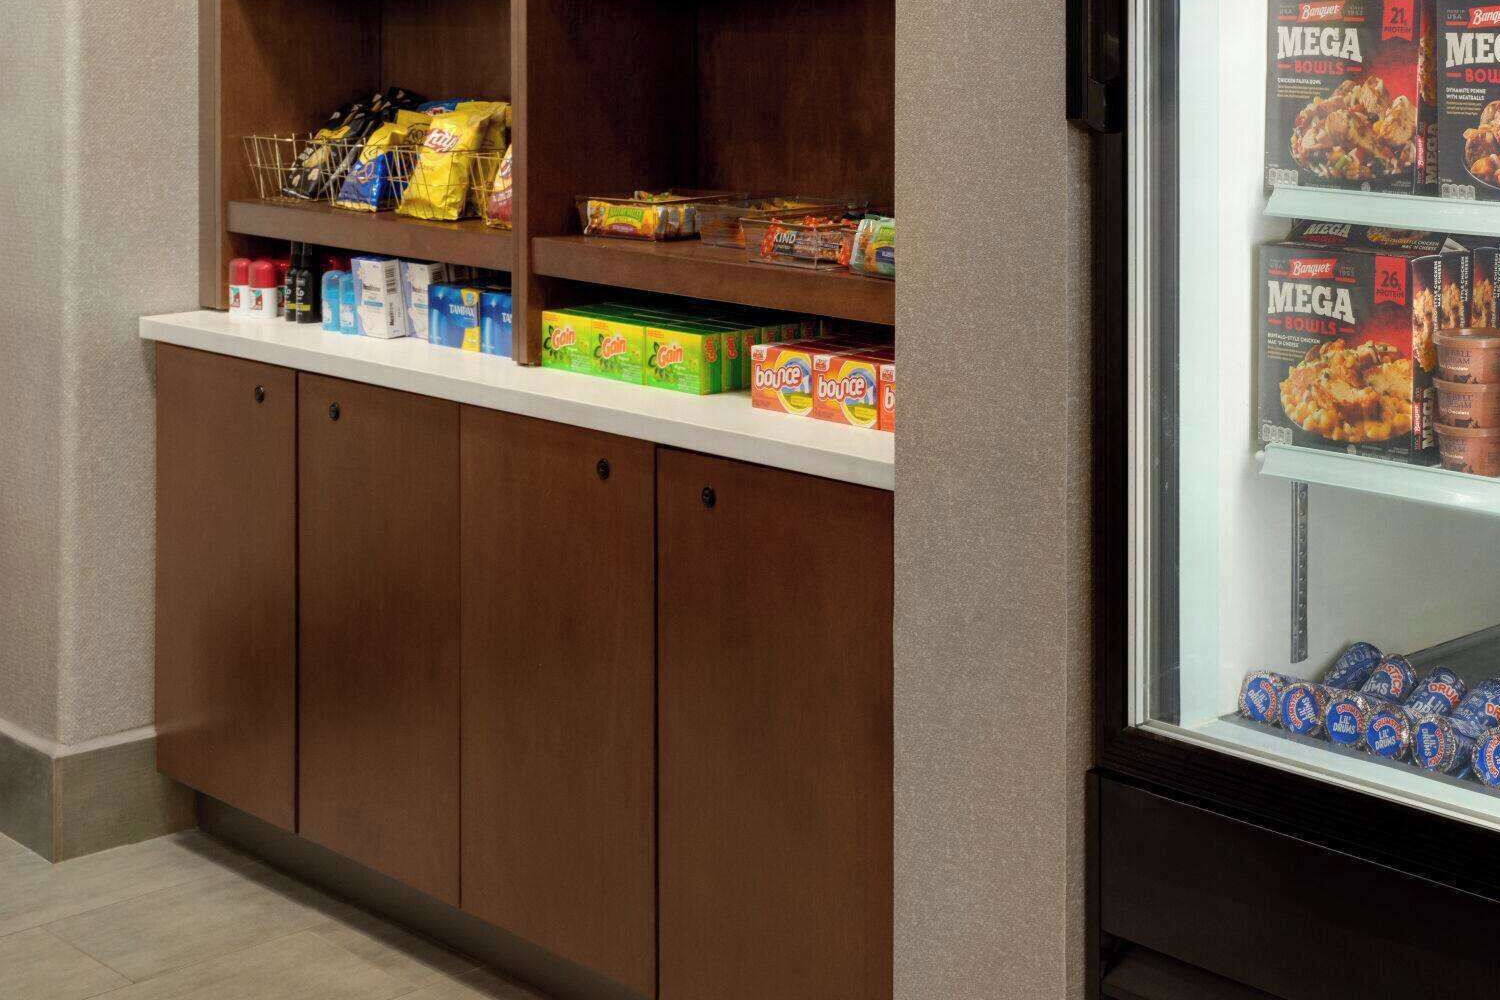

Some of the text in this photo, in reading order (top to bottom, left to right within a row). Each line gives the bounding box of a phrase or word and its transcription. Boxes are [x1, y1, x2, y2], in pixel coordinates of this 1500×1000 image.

[1302, 3, 1341, 20] Banquet
[1277, 26, 1363, 63] MEGA
[1295, 60, 1344, 75] BOWLS
[1425, 125, 1438, 184] MEGA
[774, 231, 796, 245] KIND
[1293, 260, 1332, 276] Banquet
[1267, 280, 1355, 324] MEGA
[551, 327, 577, 349] Gain
[1285, 318, 1337, 336] BOWLS
[600, 336, 628, 358] Gain
[656, 346, 685, 369] Gain
[754, 364, 802, 390] bounce
[817, 375, 869, 401] bounce
[1422, 389, 1434, 449] MEGA
[1333, 722, 1356, 735] DRUMS
[1375, 737, 1397, 751] DRUMS
[1422, 727, 1432, 756] DRUMS
